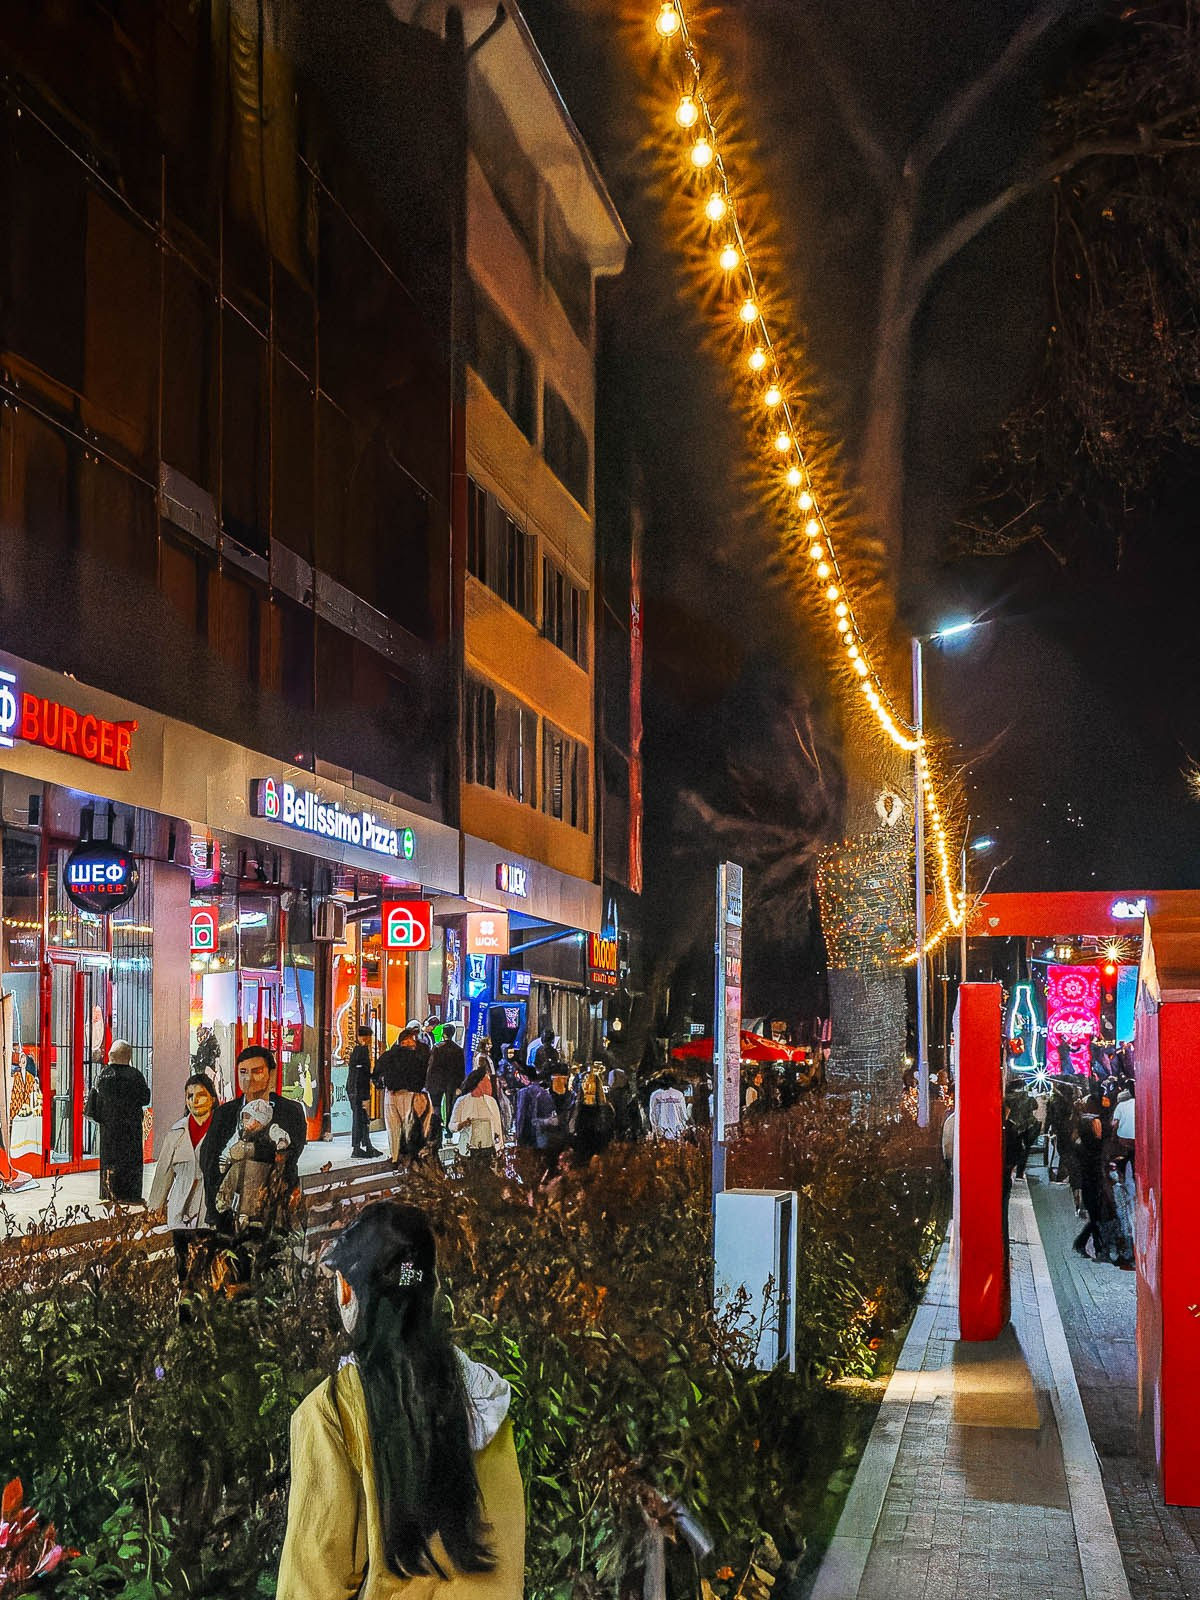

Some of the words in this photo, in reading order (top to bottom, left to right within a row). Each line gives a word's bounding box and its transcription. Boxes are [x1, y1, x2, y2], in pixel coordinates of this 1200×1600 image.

[21, 691, 133, 772] BURGER
[283, 783, 361, 845] Bellissimo
[362, 812, 398, 856] Pizza
[71, 864, 123, 883] ШЕФ
[71, 884, 124, 893] BURGER
